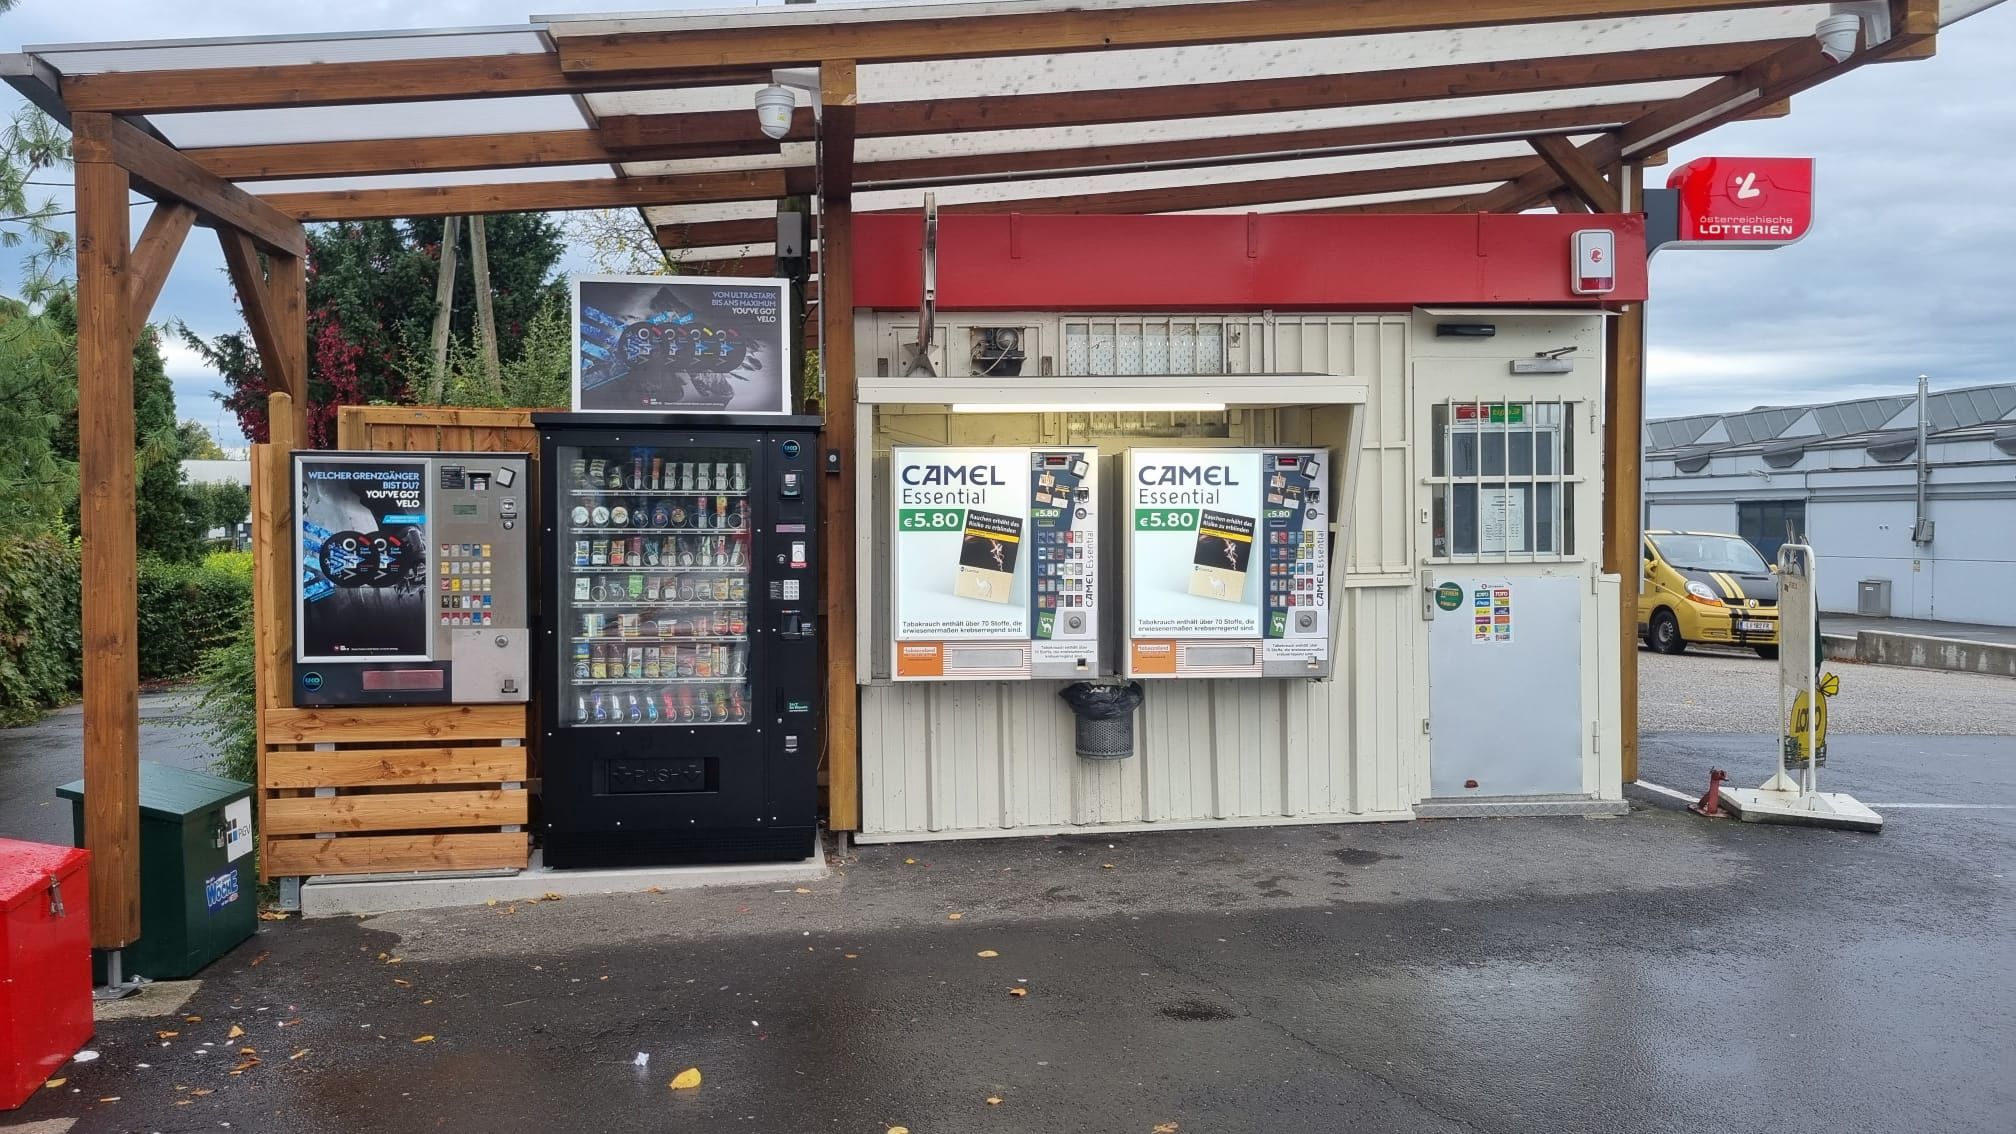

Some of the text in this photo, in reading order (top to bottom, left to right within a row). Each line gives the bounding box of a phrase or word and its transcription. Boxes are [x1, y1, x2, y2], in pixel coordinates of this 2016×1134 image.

[1700, 225, 1793, 235] LOTTERIEN
[731, 291, 776, 299] ULTRASTARK
[732, 307, 760, 315] YOU'VE
[308, 470, 420, 480] WELCHER GRENZGÄNGER
[902, 464, 1005, 486] CAMEL
[1138, 465, 1239, 486] CAMEL
[383, 481, 420, 489] BIST DU?
[366, 490, 420, 498] YOU'VE GOT
[903, 488, 985, 504] Essential
[1139, 488, 1219, 504] Essential
[396, 500, 420, 508] VELO
[904, 512, 958, 527] €5.80
[1140, 512, 1193, 527] €5.80
[1085, 530, 1094, 608] CAMEL Essential
[1316, 530, 1324, 607] CAMEL Essential
[1795, 706, 1822, 733] LOO
[206, 870, 239, 907] WOCHE
